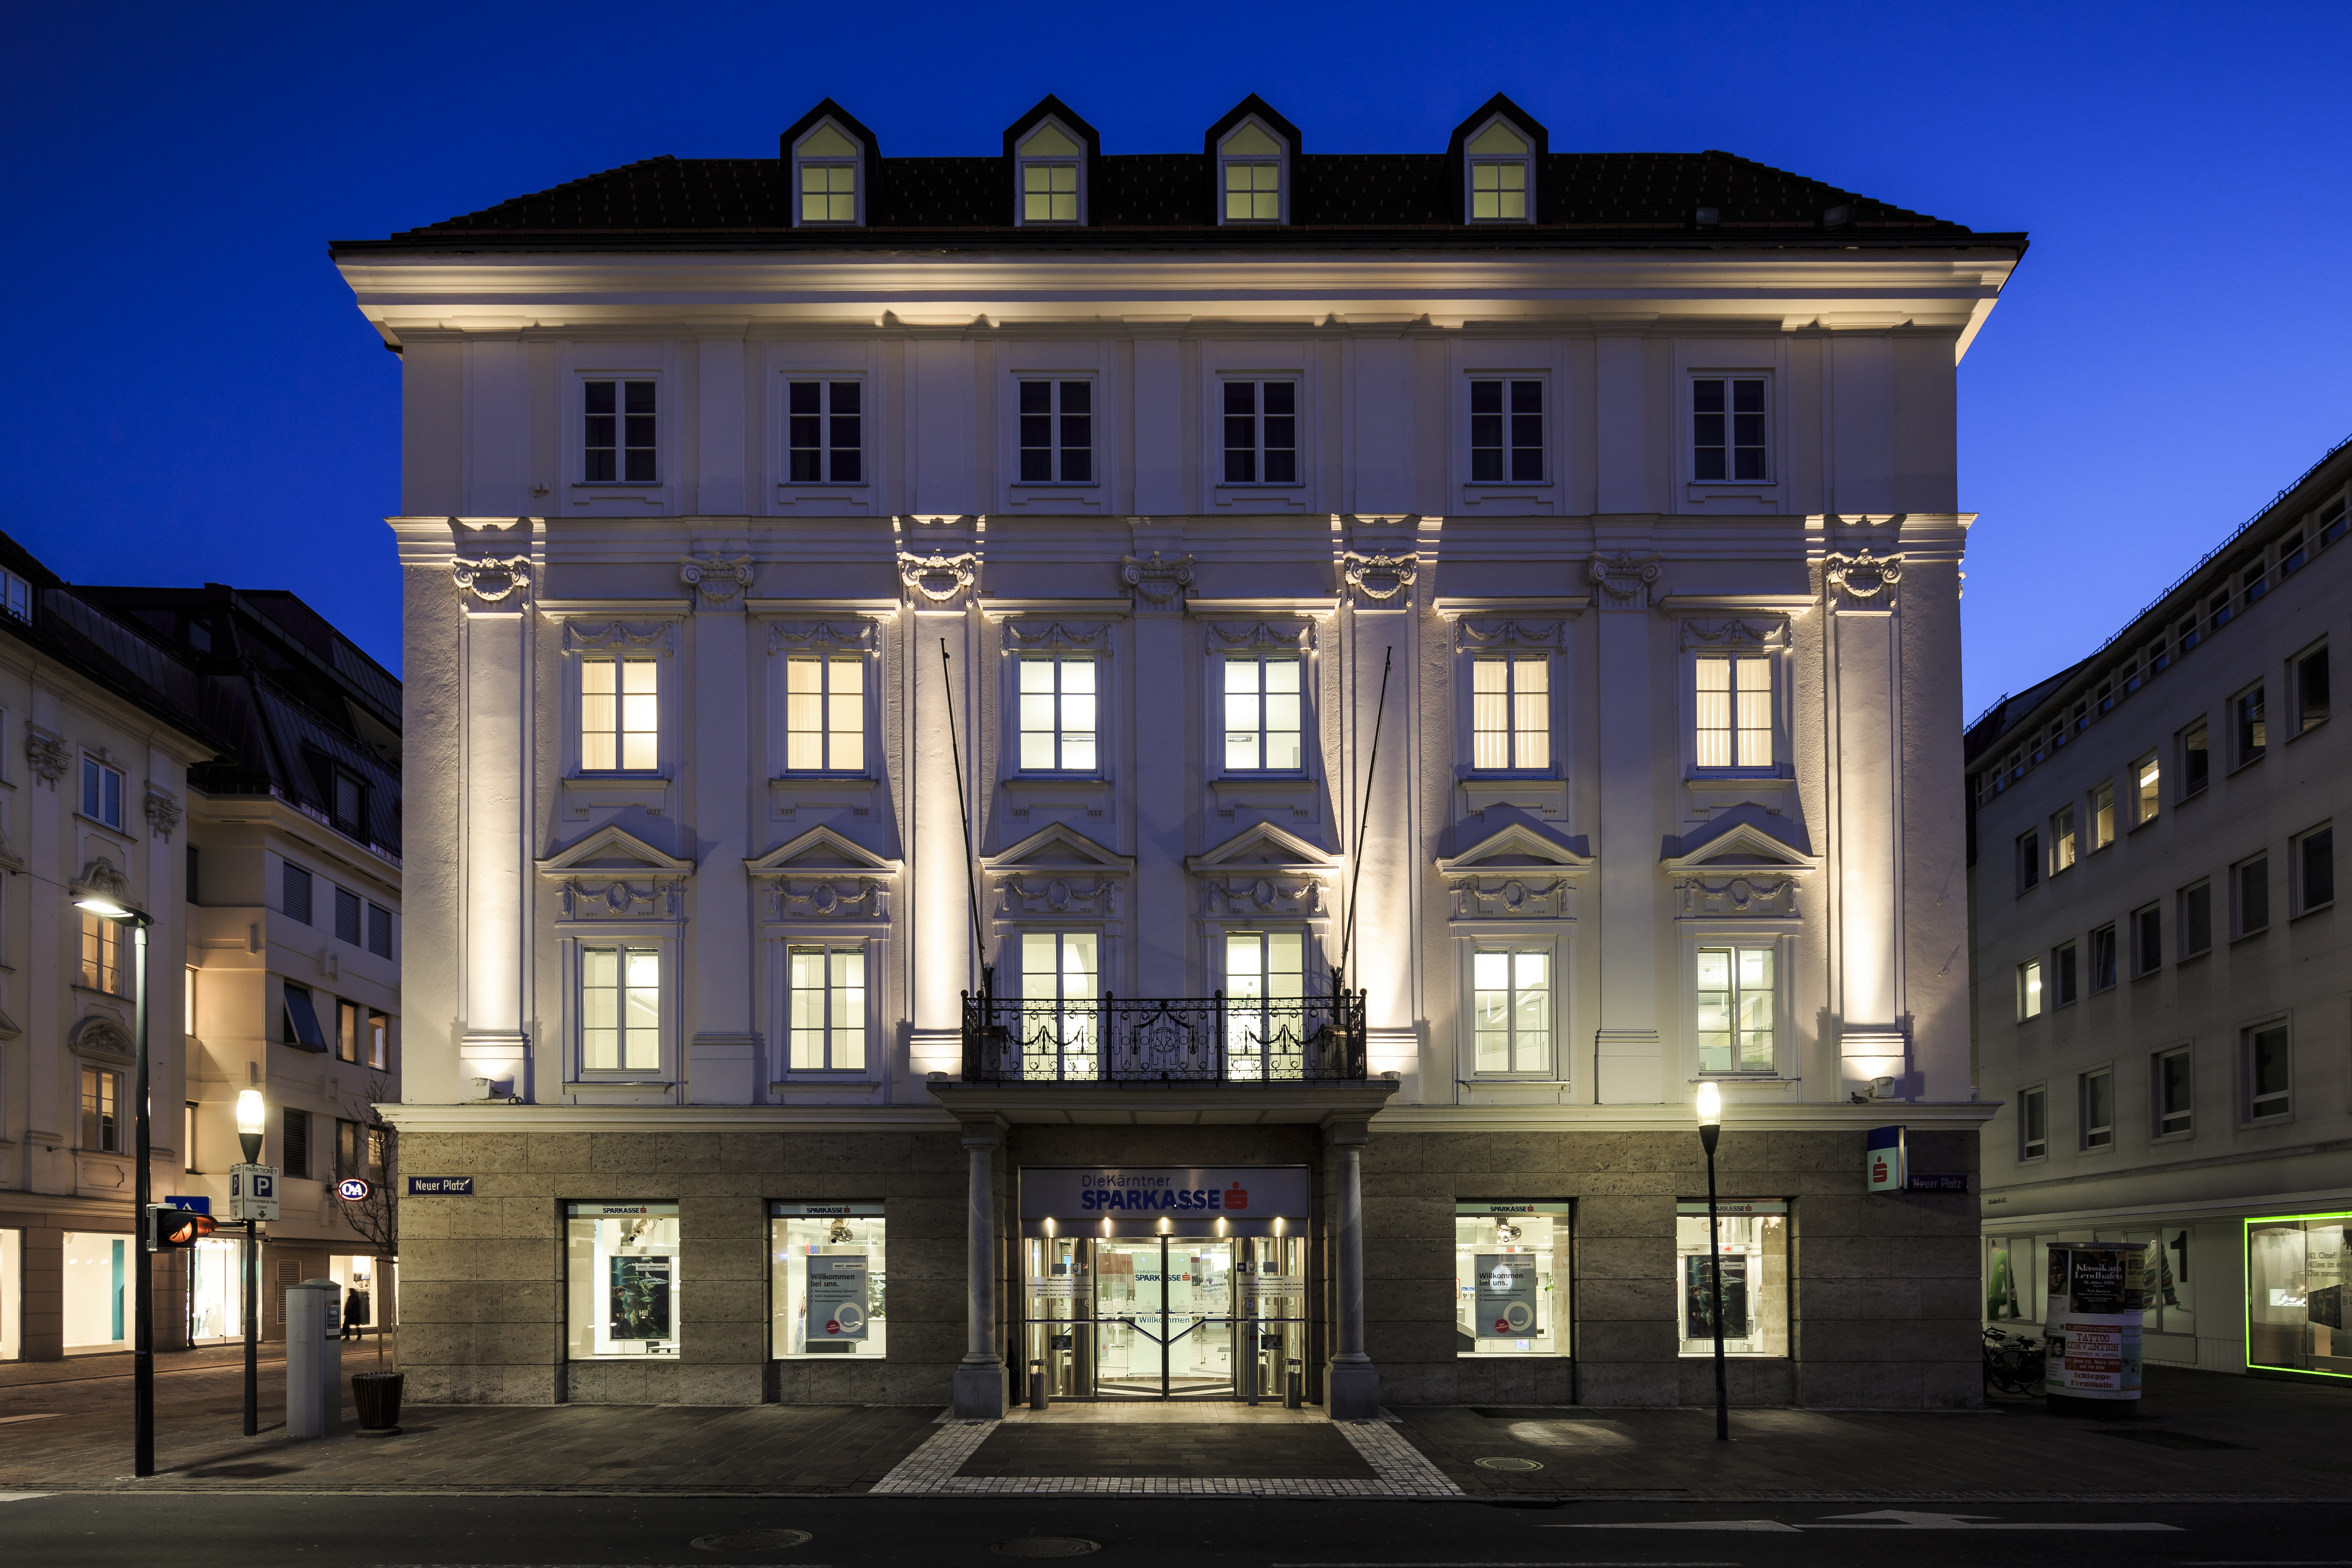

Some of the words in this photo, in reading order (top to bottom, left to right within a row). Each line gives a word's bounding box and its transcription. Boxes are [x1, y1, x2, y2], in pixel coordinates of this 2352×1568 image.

[416, 1180, 440, 1190] Neuer
[443, 1180, 464, 1190] Platz
[1082, 1175, 1171, 1187] DieKärntner
[1913, 1178, 1938, 1189] Neuer
[1941, 1178, 1962, 1189] Platz
[257, 1178, 269, 1195] P
[342, 1183, 364, 1196] C&A
[1081, 1190, 1220, 1210] SPARKASSE
[2076, 1333, 2110, 1342] TATTOO
[2067, 1341, 2119, 1351] CONVENTION
[2074, 1372, 2110, 1380] Schleppe
[2071, 1380, 2113, 1388] Eventhalle
